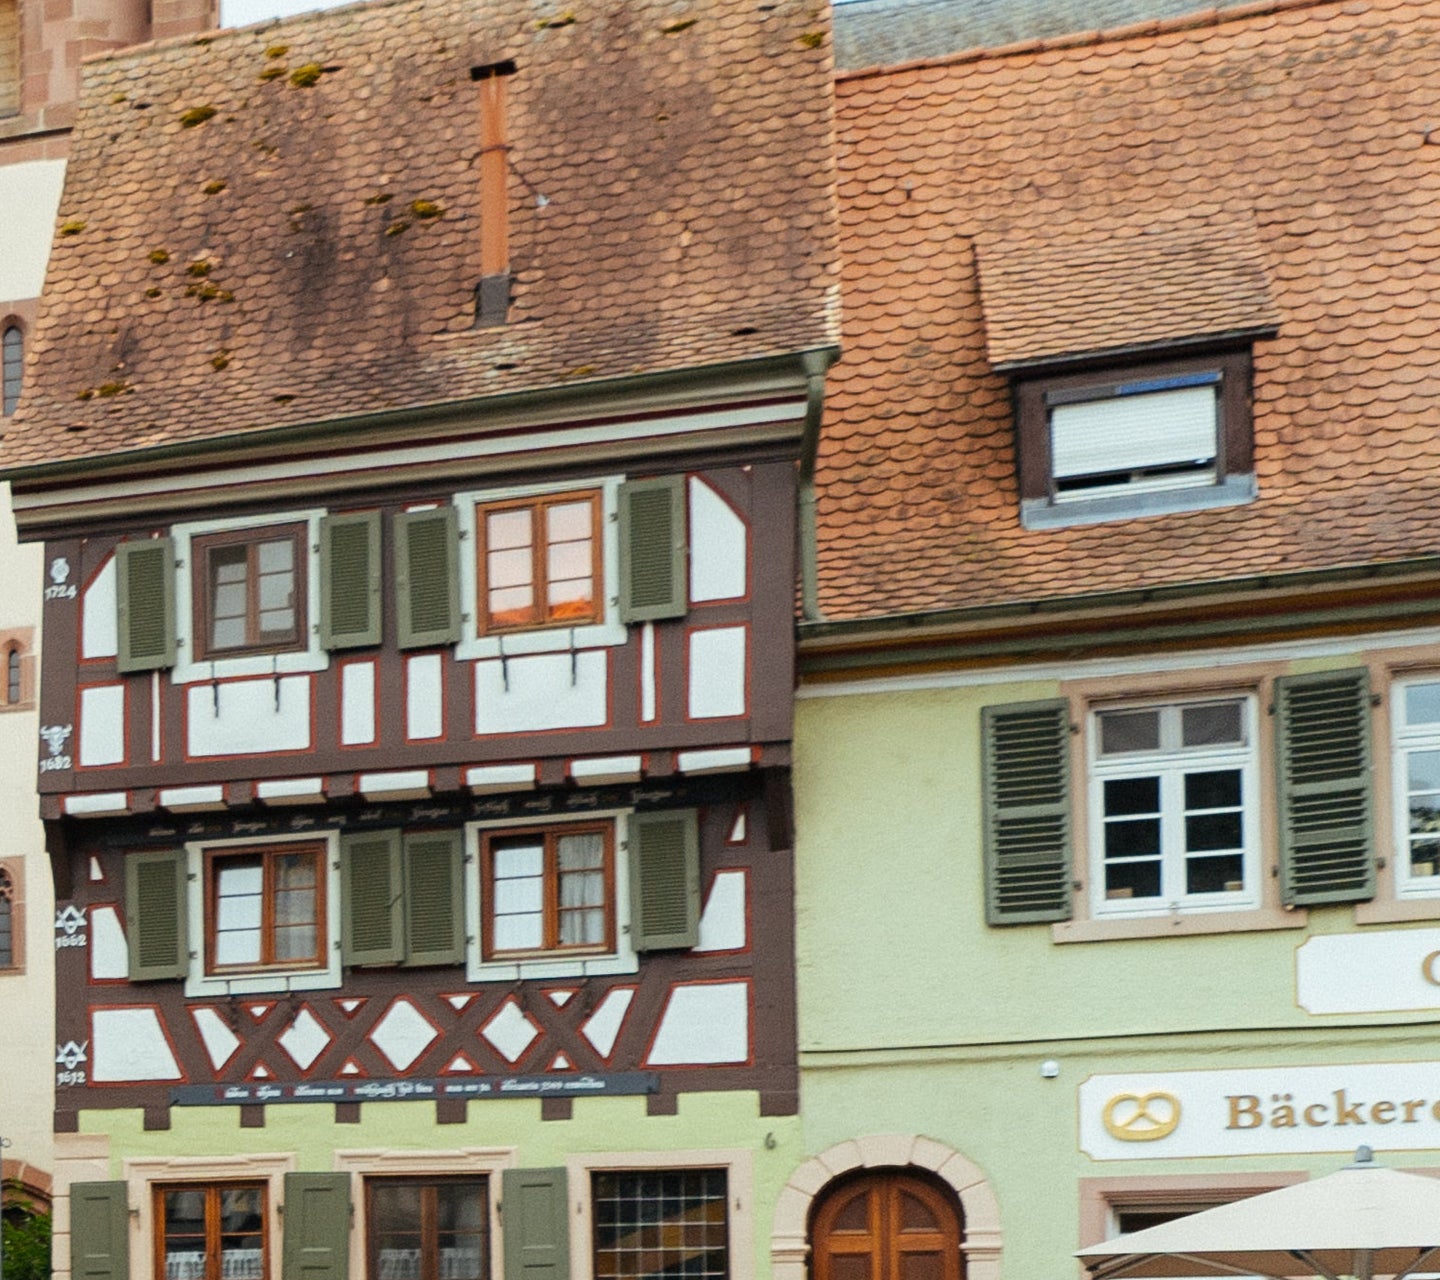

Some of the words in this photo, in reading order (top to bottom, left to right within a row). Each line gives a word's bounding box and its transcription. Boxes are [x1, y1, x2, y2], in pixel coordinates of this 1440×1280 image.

[44, 583, 77, 602] 1724
[1224, 1089, 1440, 1131] Bäcker
[765, 1132, 777, 1151] 6
